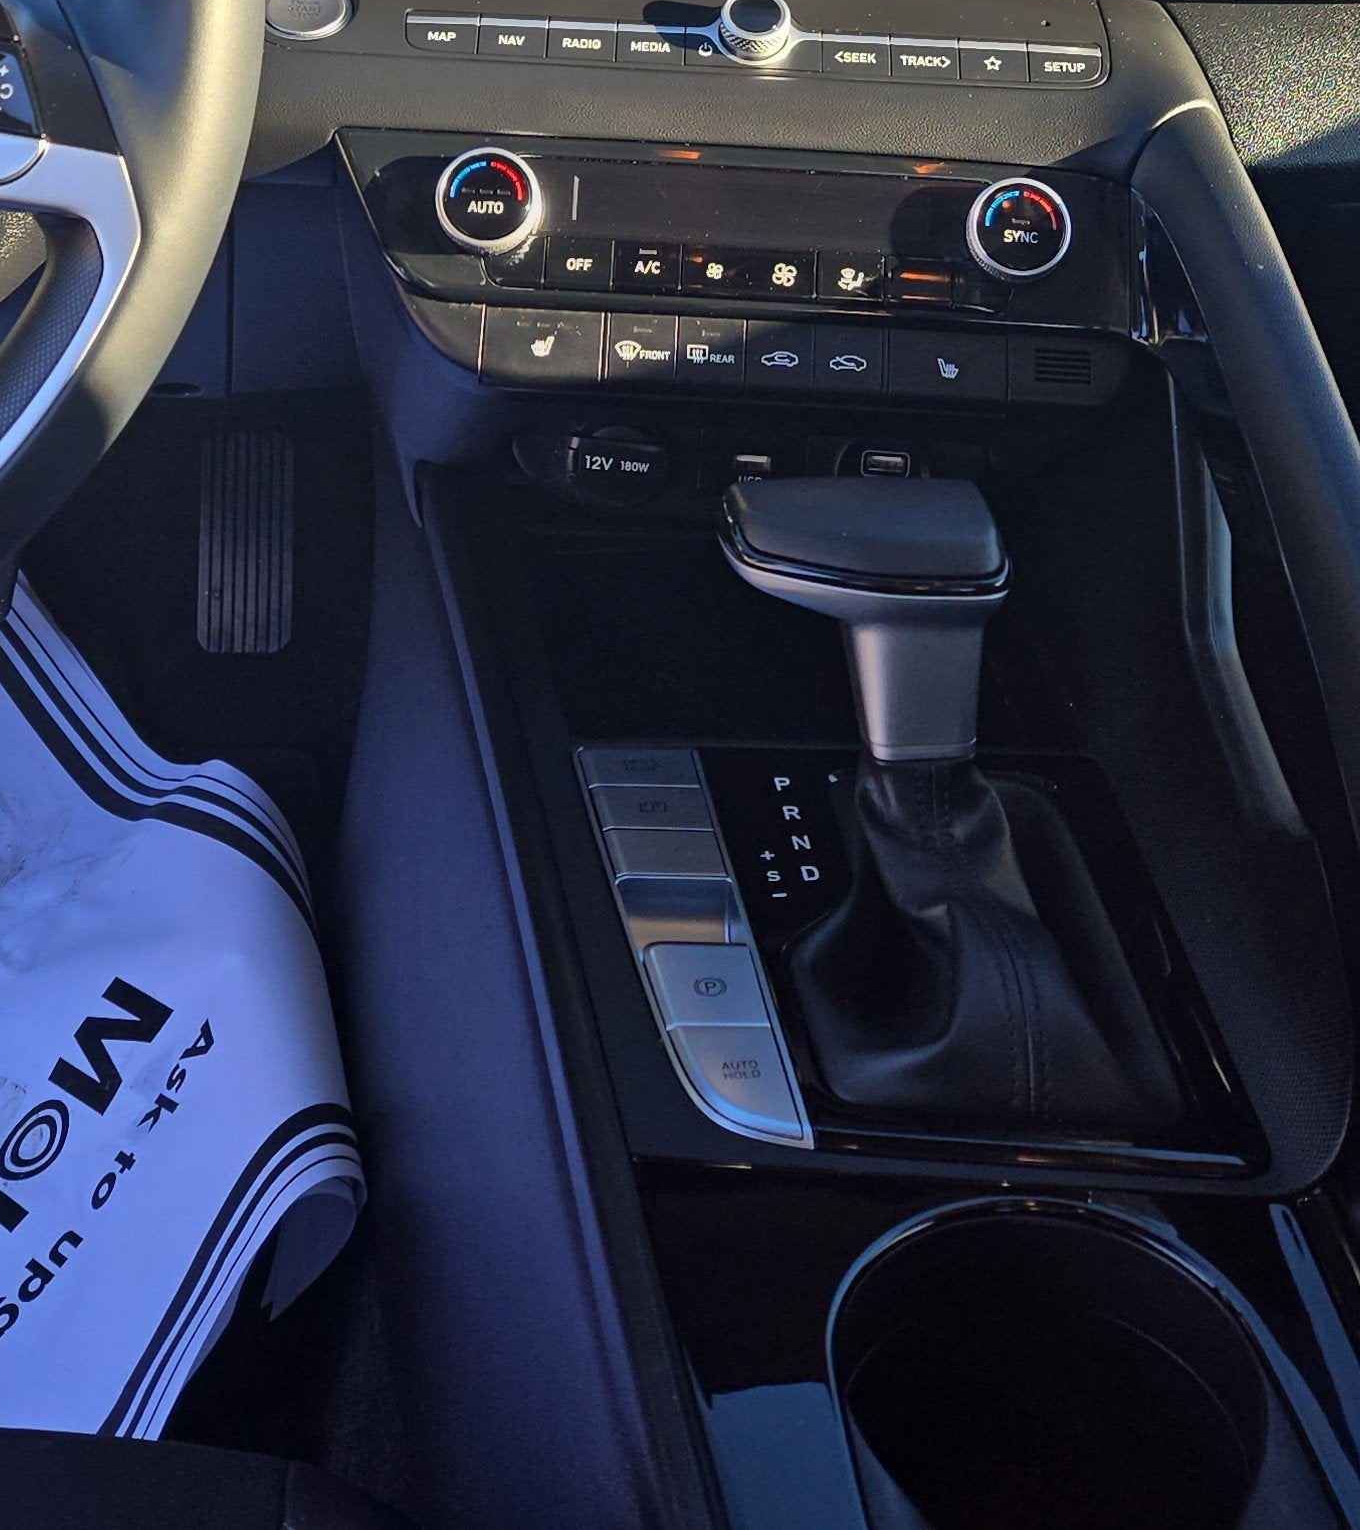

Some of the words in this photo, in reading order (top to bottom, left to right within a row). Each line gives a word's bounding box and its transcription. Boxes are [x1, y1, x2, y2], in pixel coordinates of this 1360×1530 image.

[427, 31, 456, 42] MAP
[498, 34, 526, 46] NAV
[562, 37, 602, 49] RADIO
[630, 41, 671, 53] MEDIA
[1044, 61, 1086, 73] SETUP
[467, 200, 504, 214] AUTO
[1003, 229, 1039, 244] SYNC
[566, 258, 593, 271] OFF
[635, 260, 661, 275] A/C
[639, 349, 671, 361] FRONT
[709, 353, 735, 365] REAR
[584, 455, 614, 471] 12V
[620, 460, 650, 473] 180W
[774, 777, 791, 791] P
[782, 805, 801, 820] R
[791, 835, 811, 850] N
[766, 870, 781, 882] S
[800, 865, 820, 881] D
[722, 1059, 758, 1070] AUTO
[137, 1018, 216, 1132] Ask
[723, 1070, 761, 1080] HOLD
[91, 1150, 137, 1210] to
